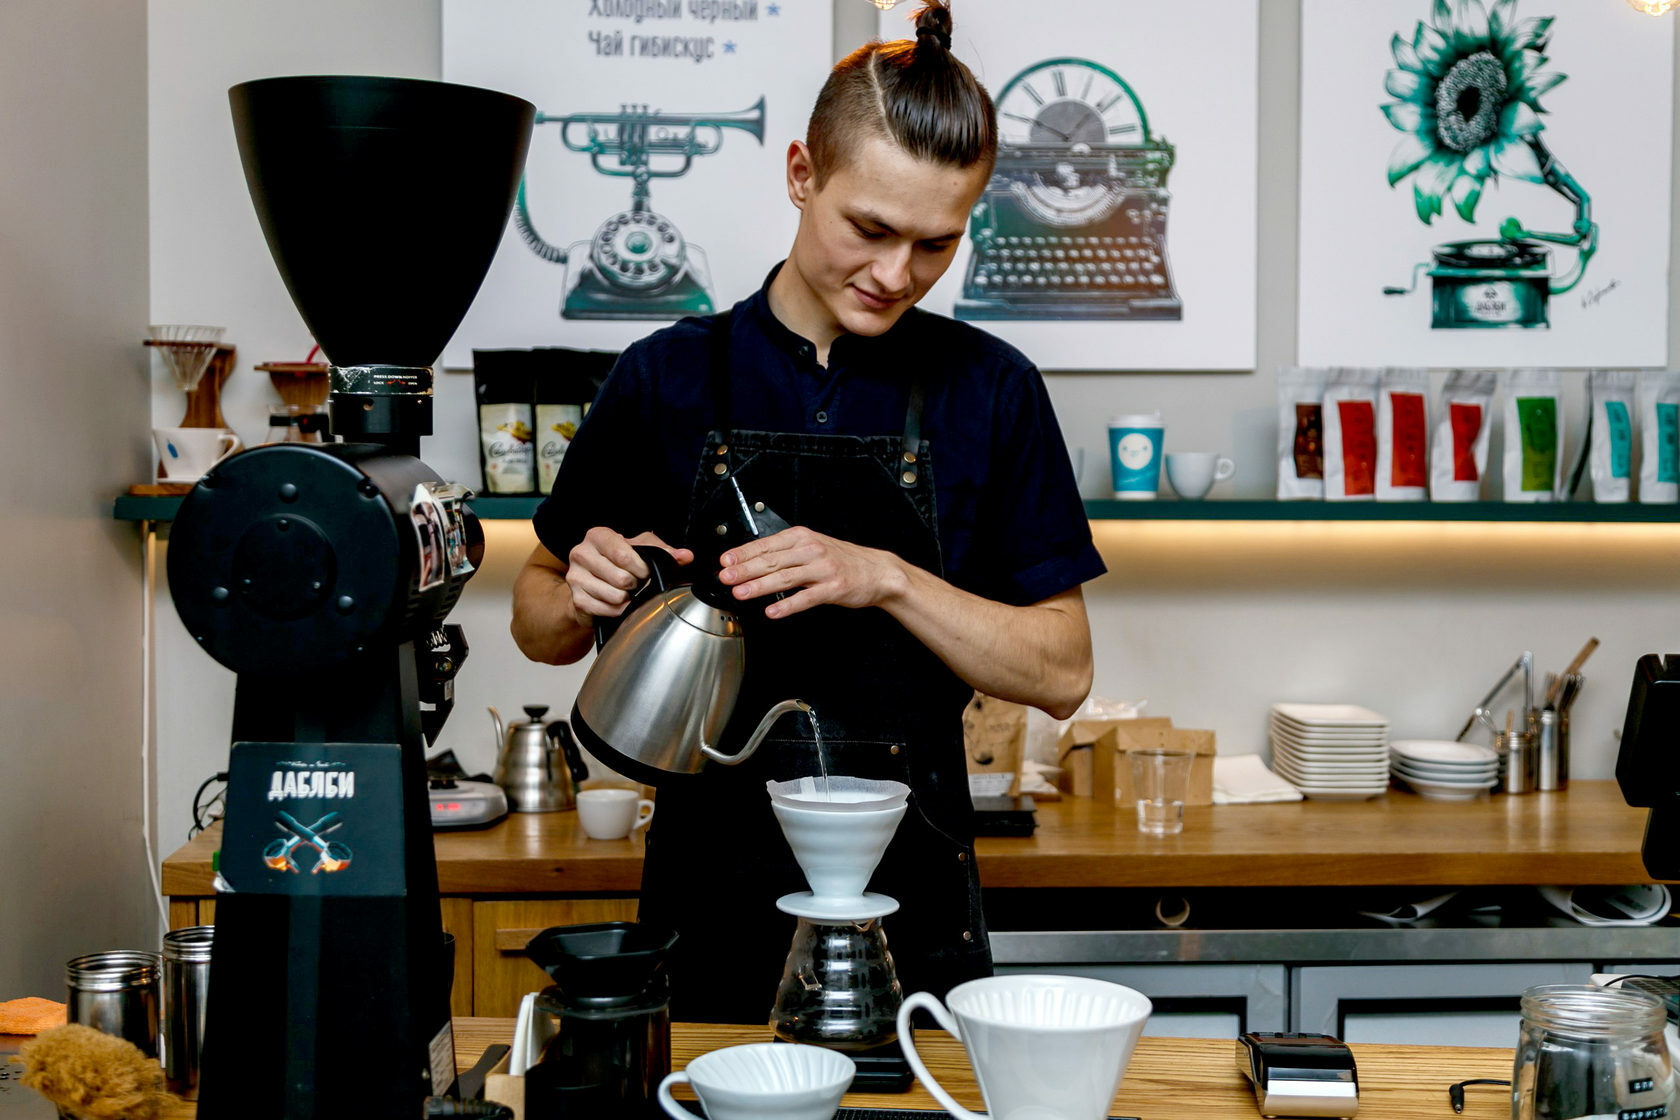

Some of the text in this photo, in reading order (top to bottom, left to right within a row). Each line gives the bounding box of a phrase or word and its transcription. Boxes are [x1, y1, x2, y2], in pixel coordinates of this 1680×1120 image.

[588, 30, 715, 63] Чай гибискус
[268, 770, 355, 802] ДАБЛБИ
